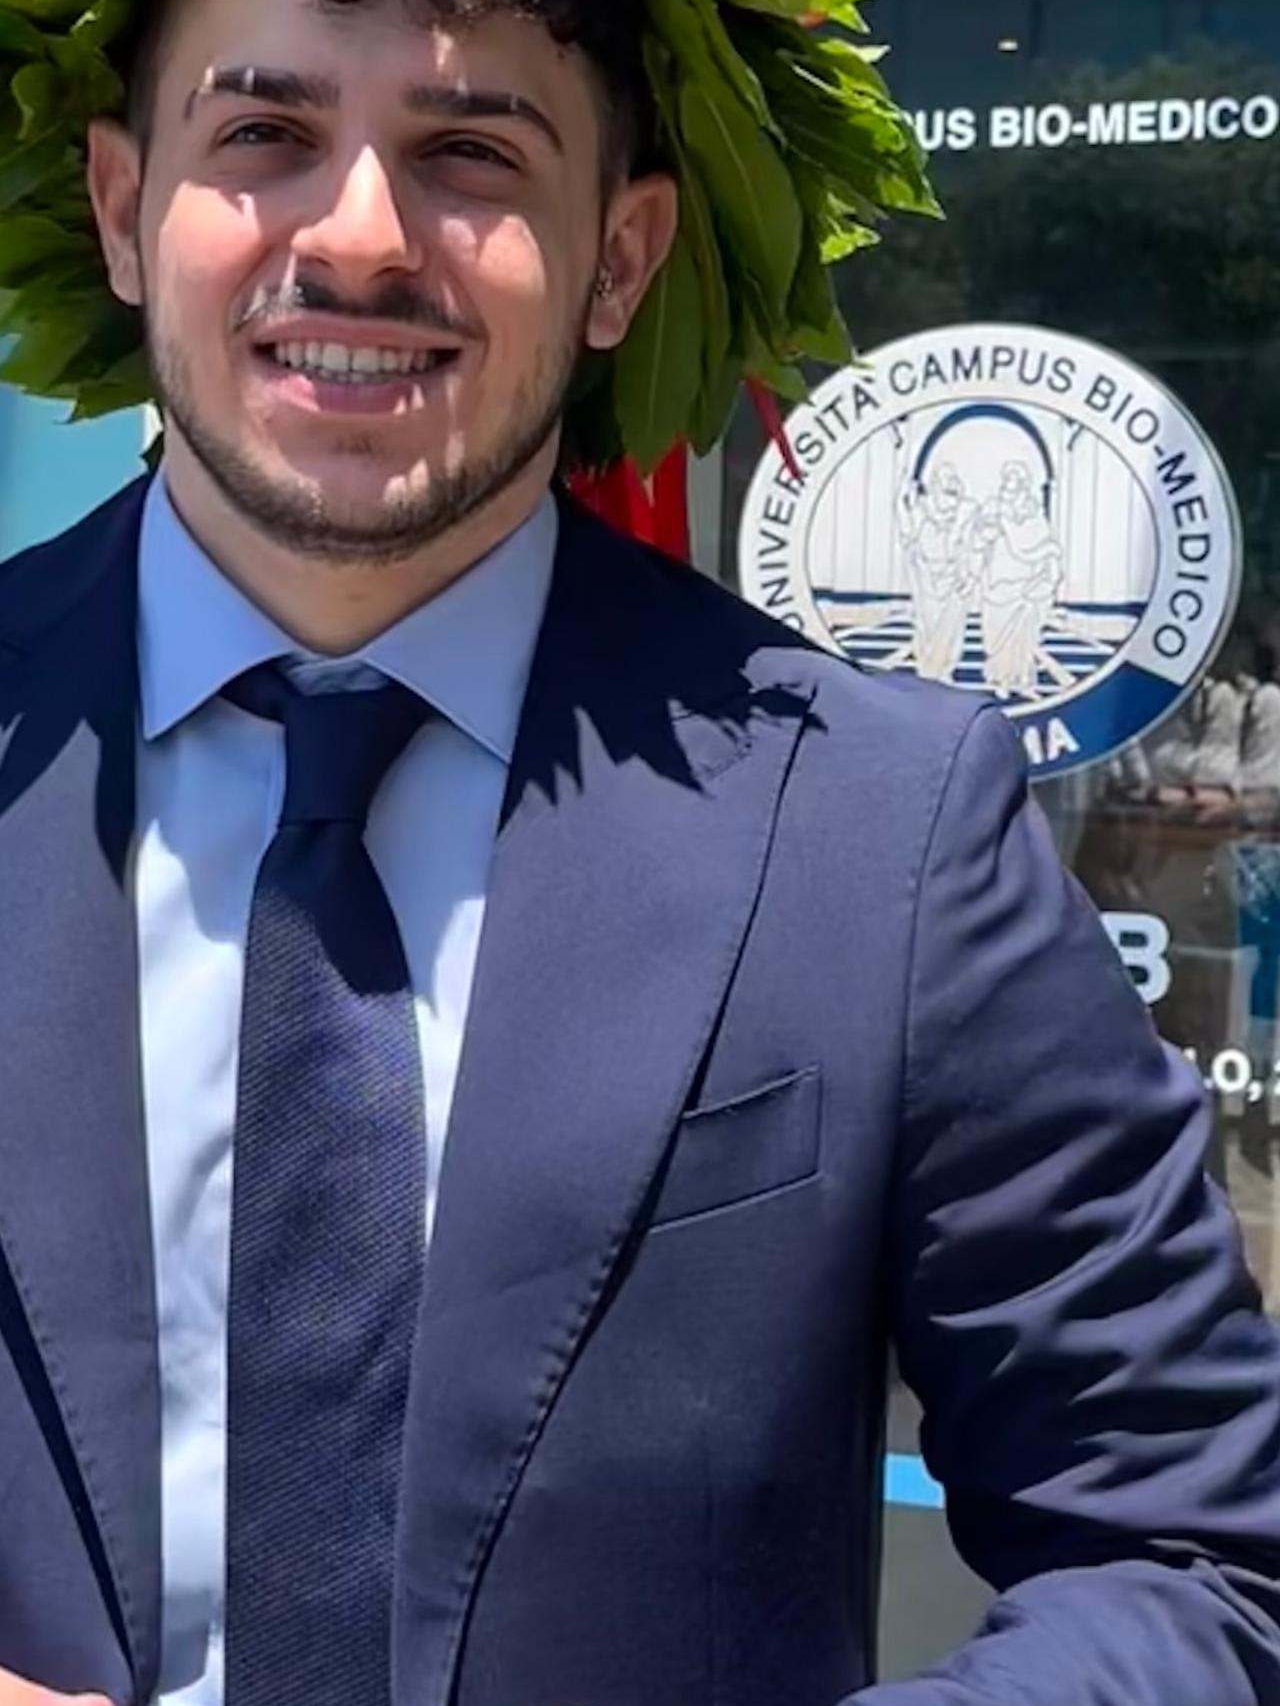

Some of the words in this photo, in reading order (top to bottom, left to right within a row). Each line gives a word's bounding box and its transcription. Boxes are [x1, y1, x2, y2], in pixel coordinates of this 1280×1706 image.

[989, 97, 1280, 148] BIO-MEDICO
[888, 345, 1078, 396] CAMPUS
[1084, 373, 1212, 661] BIO-MEDICO
